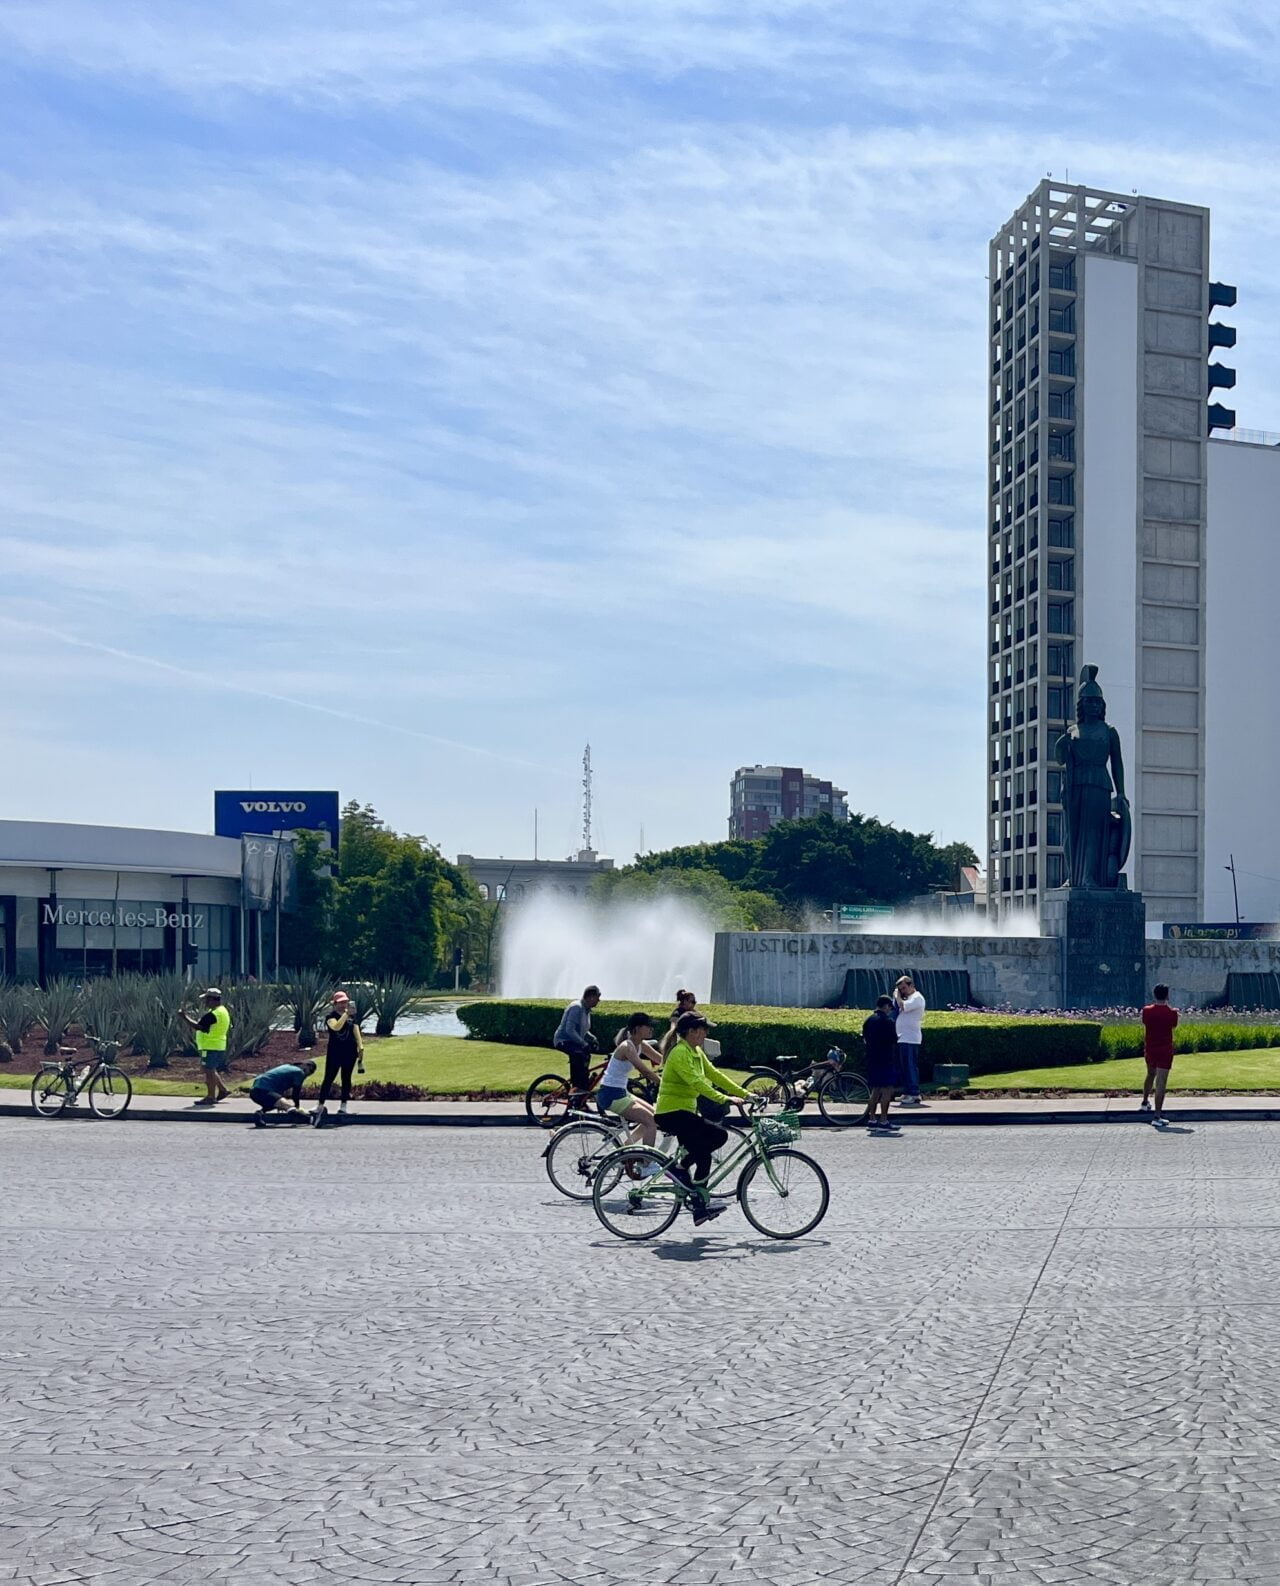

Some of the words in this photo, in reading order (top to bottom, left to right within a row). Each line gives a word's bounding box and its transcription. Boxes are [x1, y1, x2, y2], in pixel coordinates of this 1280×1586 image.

[240, 801, 307, 813] VOLVO
[42, 903, 205, 929] Mercedes-Benz
[736, 938, 820, 956] JUSTICIA
